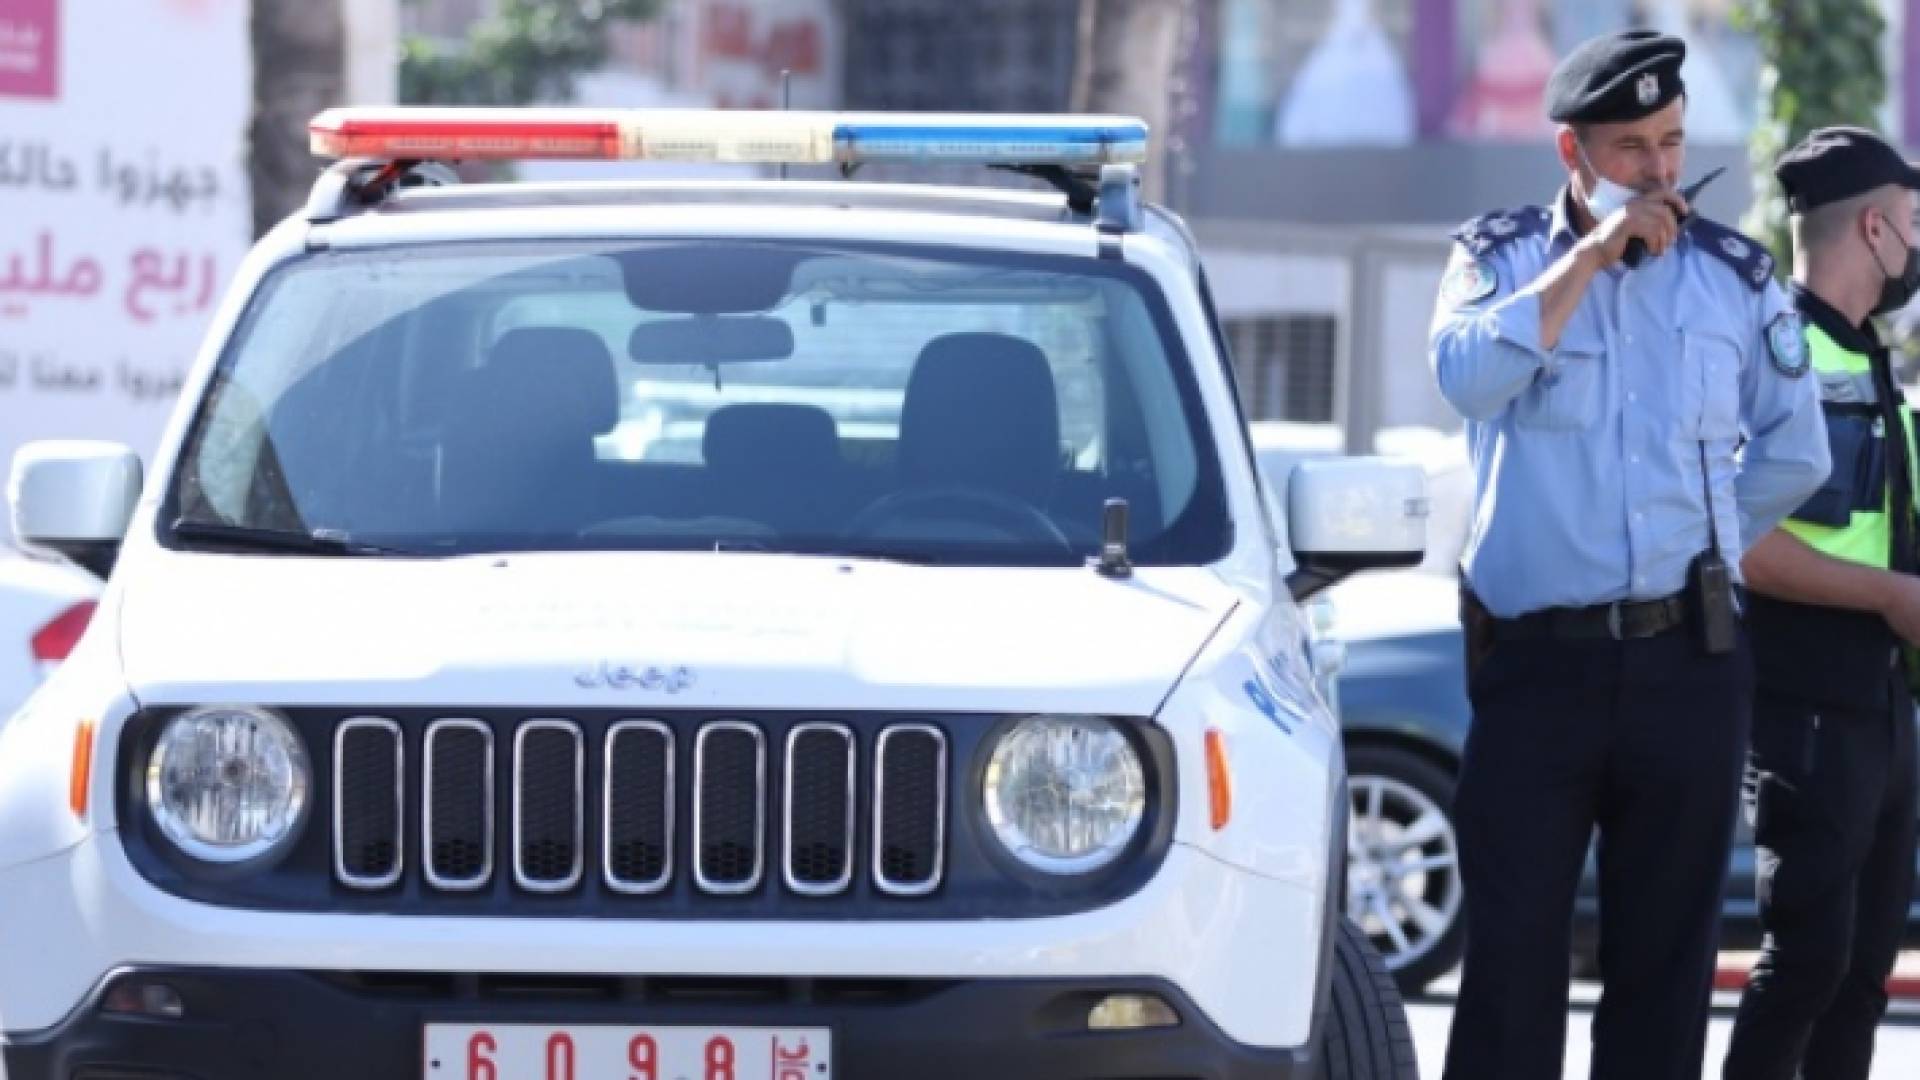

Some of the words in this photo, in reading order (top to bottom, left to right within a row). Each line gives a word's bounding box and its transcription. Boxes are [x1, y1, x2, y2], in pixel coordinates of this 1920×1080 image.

[97, 144, 218, 212] جهزوا
[0, 234, 102, 316] ملي
[124, 247, 216, 323] ربع
[573, 657, 699, 695] Jeep
